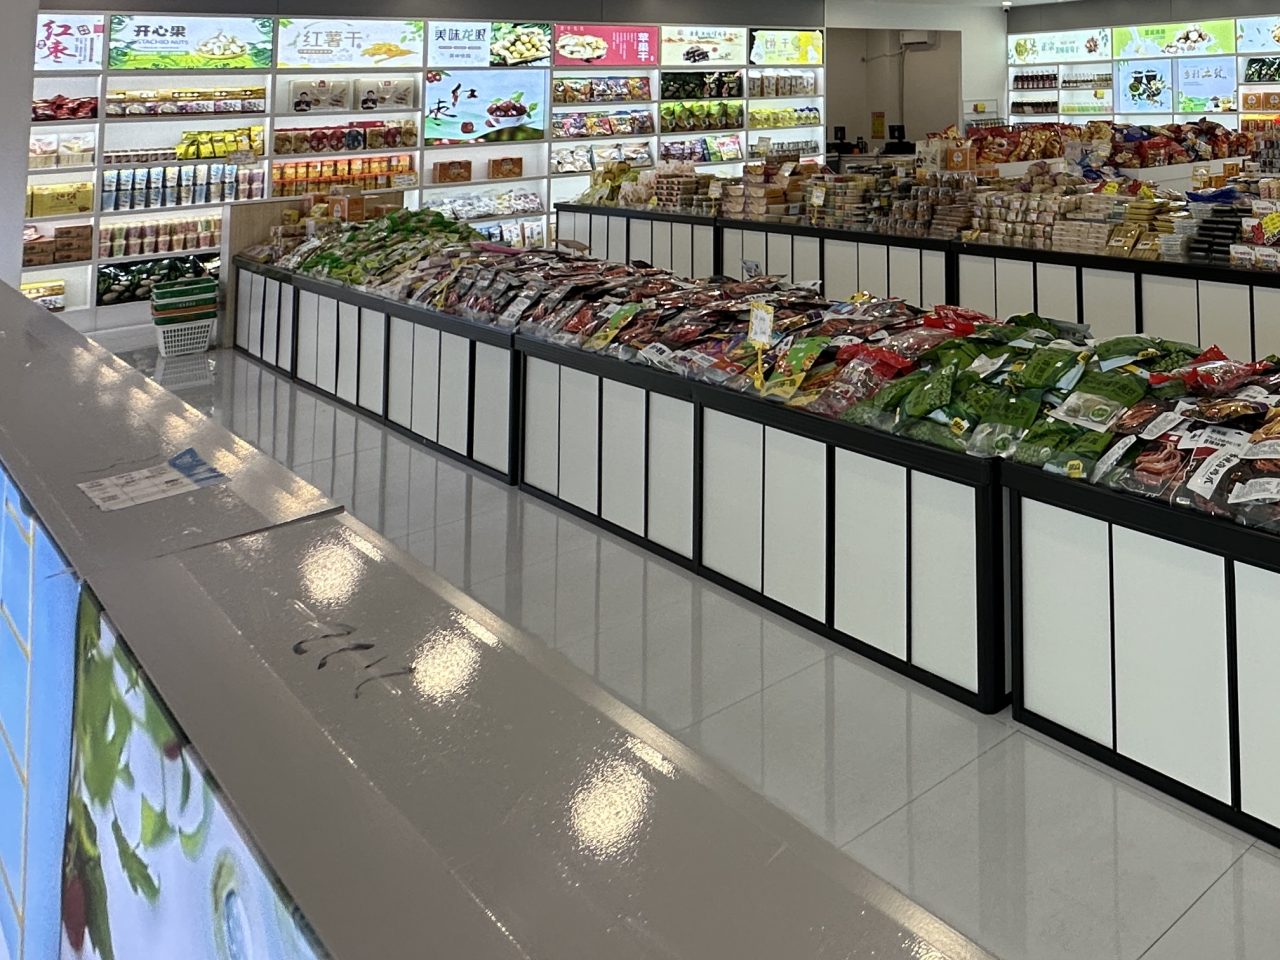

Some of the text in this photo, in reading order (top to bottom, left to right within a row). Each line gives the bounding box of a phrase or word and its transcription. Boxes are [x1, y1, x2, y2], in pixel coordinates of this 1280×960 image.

[133, 25, 187, 38] 开心果
[302, 30, 363, 47] 红薯干
[435, 28, 486, 41] 美味龙眼
[41, 19, 77, 64] 红枣
